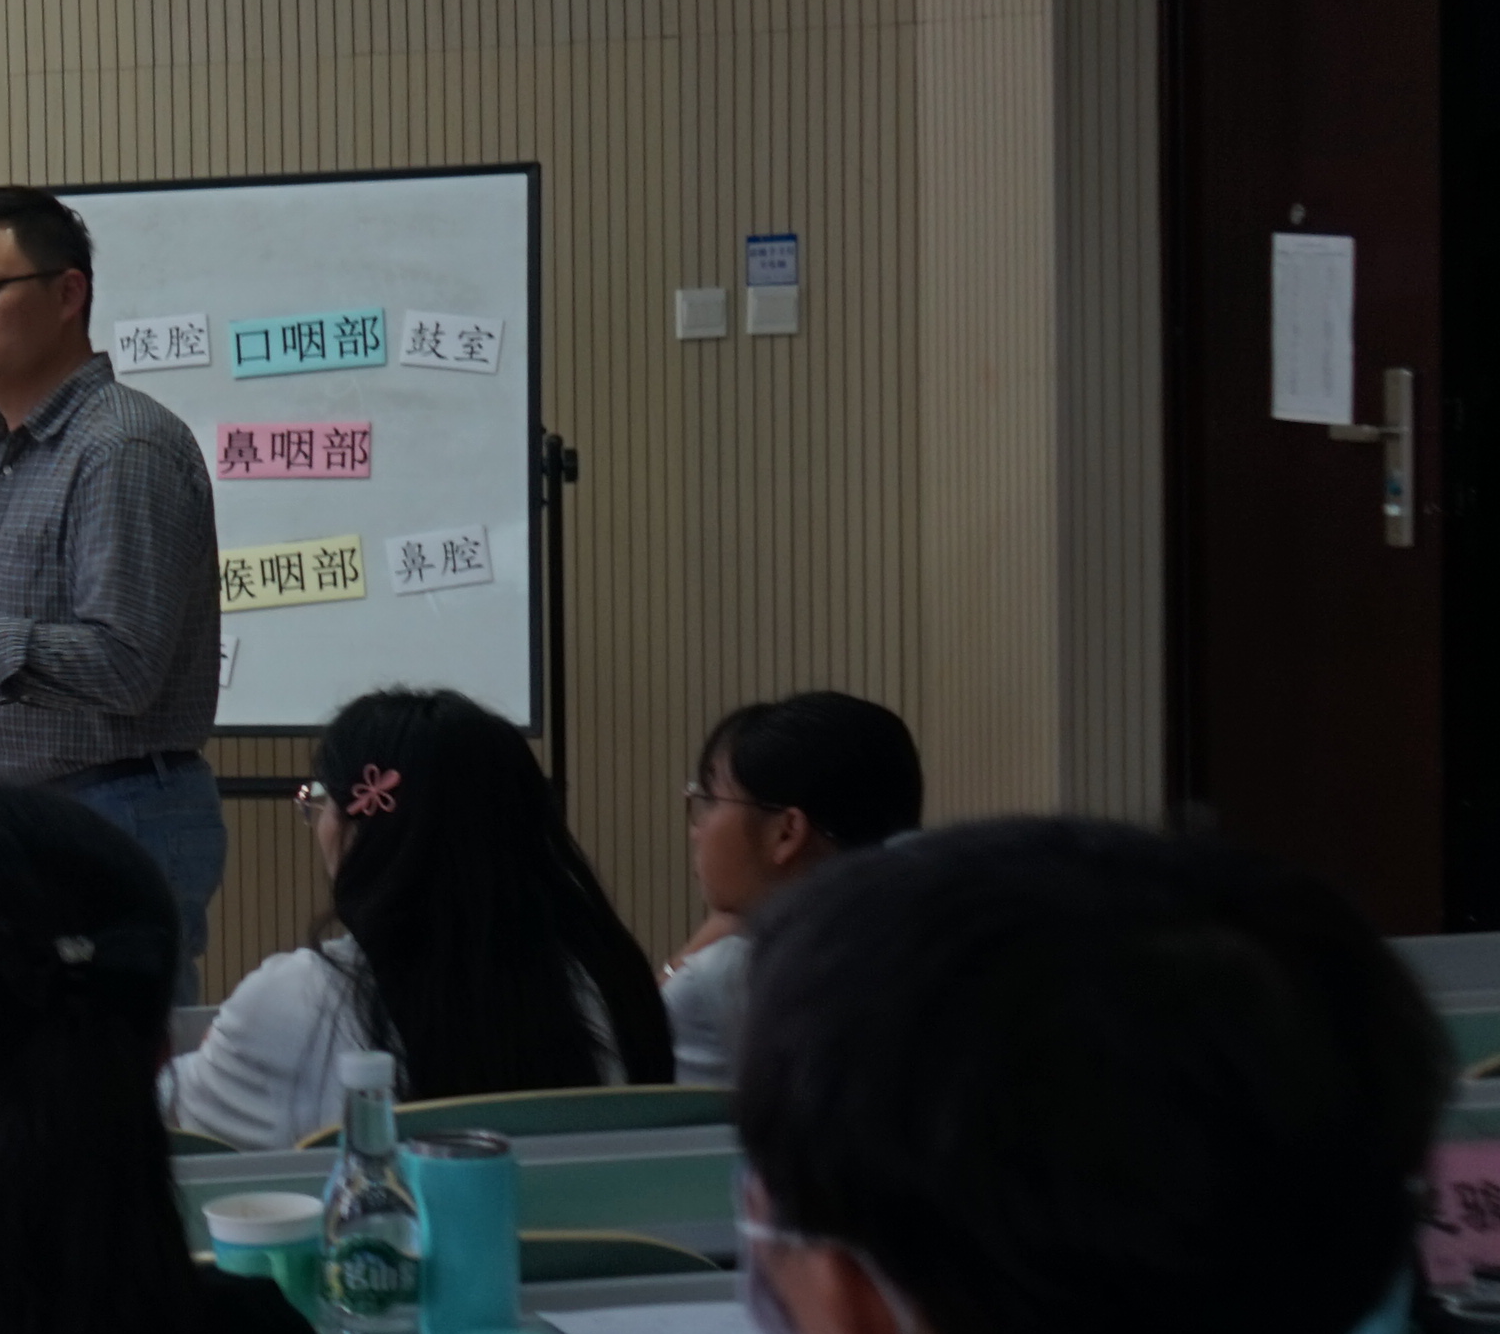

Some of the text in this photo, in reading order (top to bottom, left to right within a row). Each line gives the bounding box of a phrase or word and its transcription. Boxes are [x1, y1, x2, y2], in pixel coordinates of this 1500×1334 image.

[119, 323, 206, 363] 喉腔
[235, 316, 381, 365] 口咽部
[219, 427, 369, 474] 鼻咽部
[395, 537, 484, 583] 鼻腔
